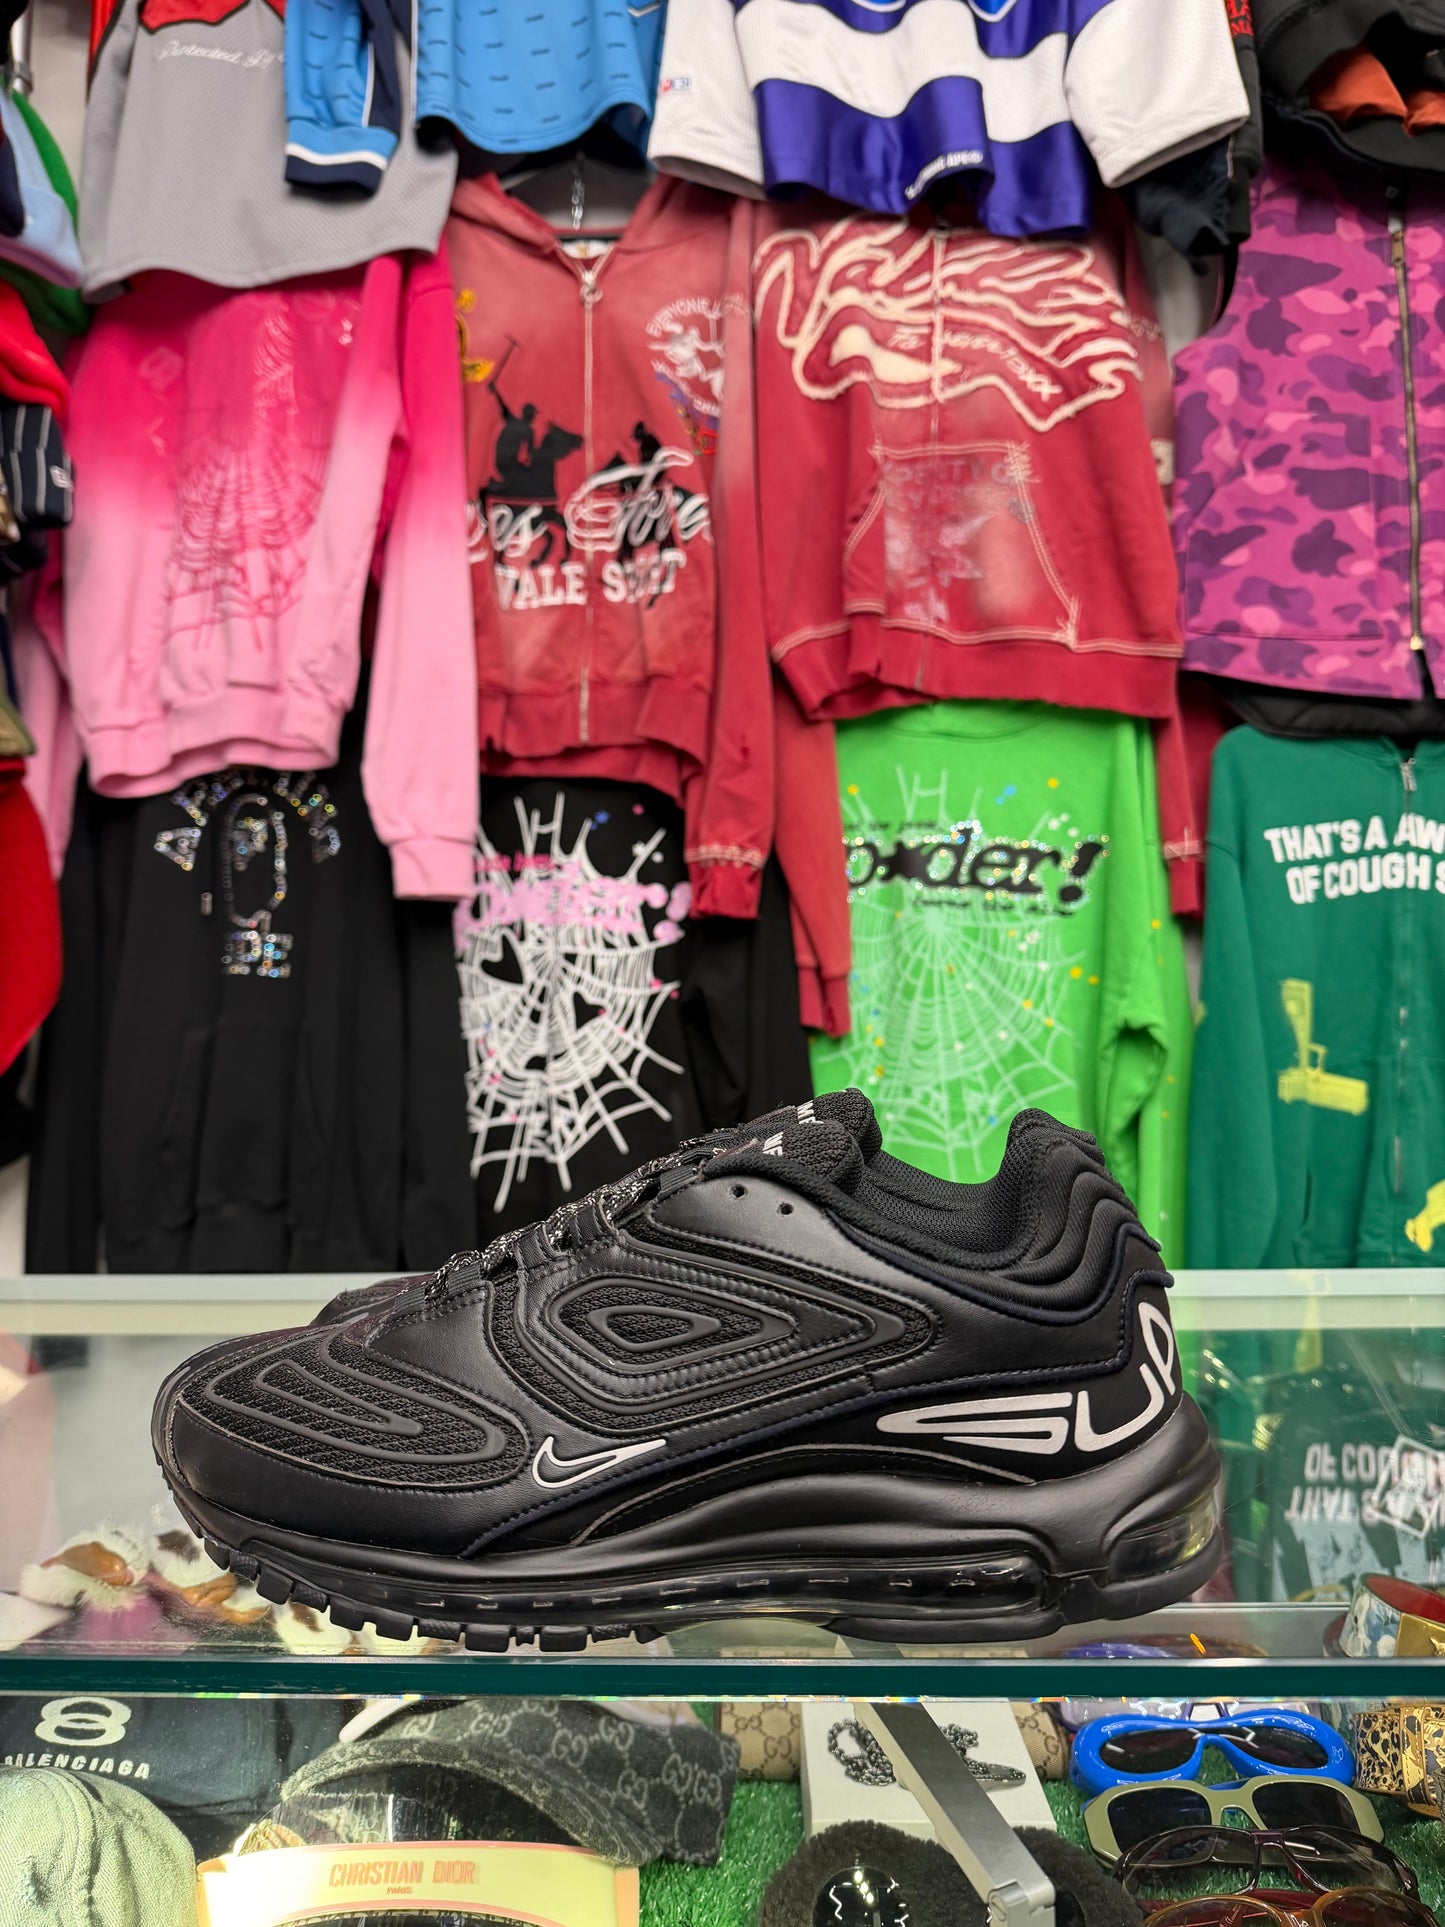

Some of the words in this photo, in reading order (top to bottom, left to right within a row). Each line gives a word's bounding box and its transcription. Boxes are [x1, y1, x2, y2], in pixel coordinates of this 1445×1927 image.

[494, 561, 588, 610] VALE
[1264, 818, 1362, 863] THAT'S
[1364, 815, 1388, 850] A
[1286, 864, 1321, 904] OF
[1323, 851, 1432, 899] COUGH
[876, 1302, 1176, 1454] SUP
[329, 1860, 424, 1887] CHRISTIAN
[433, 1860, 476, 1885] DIOR
[387, 1887, 413, 1895] PARIS
